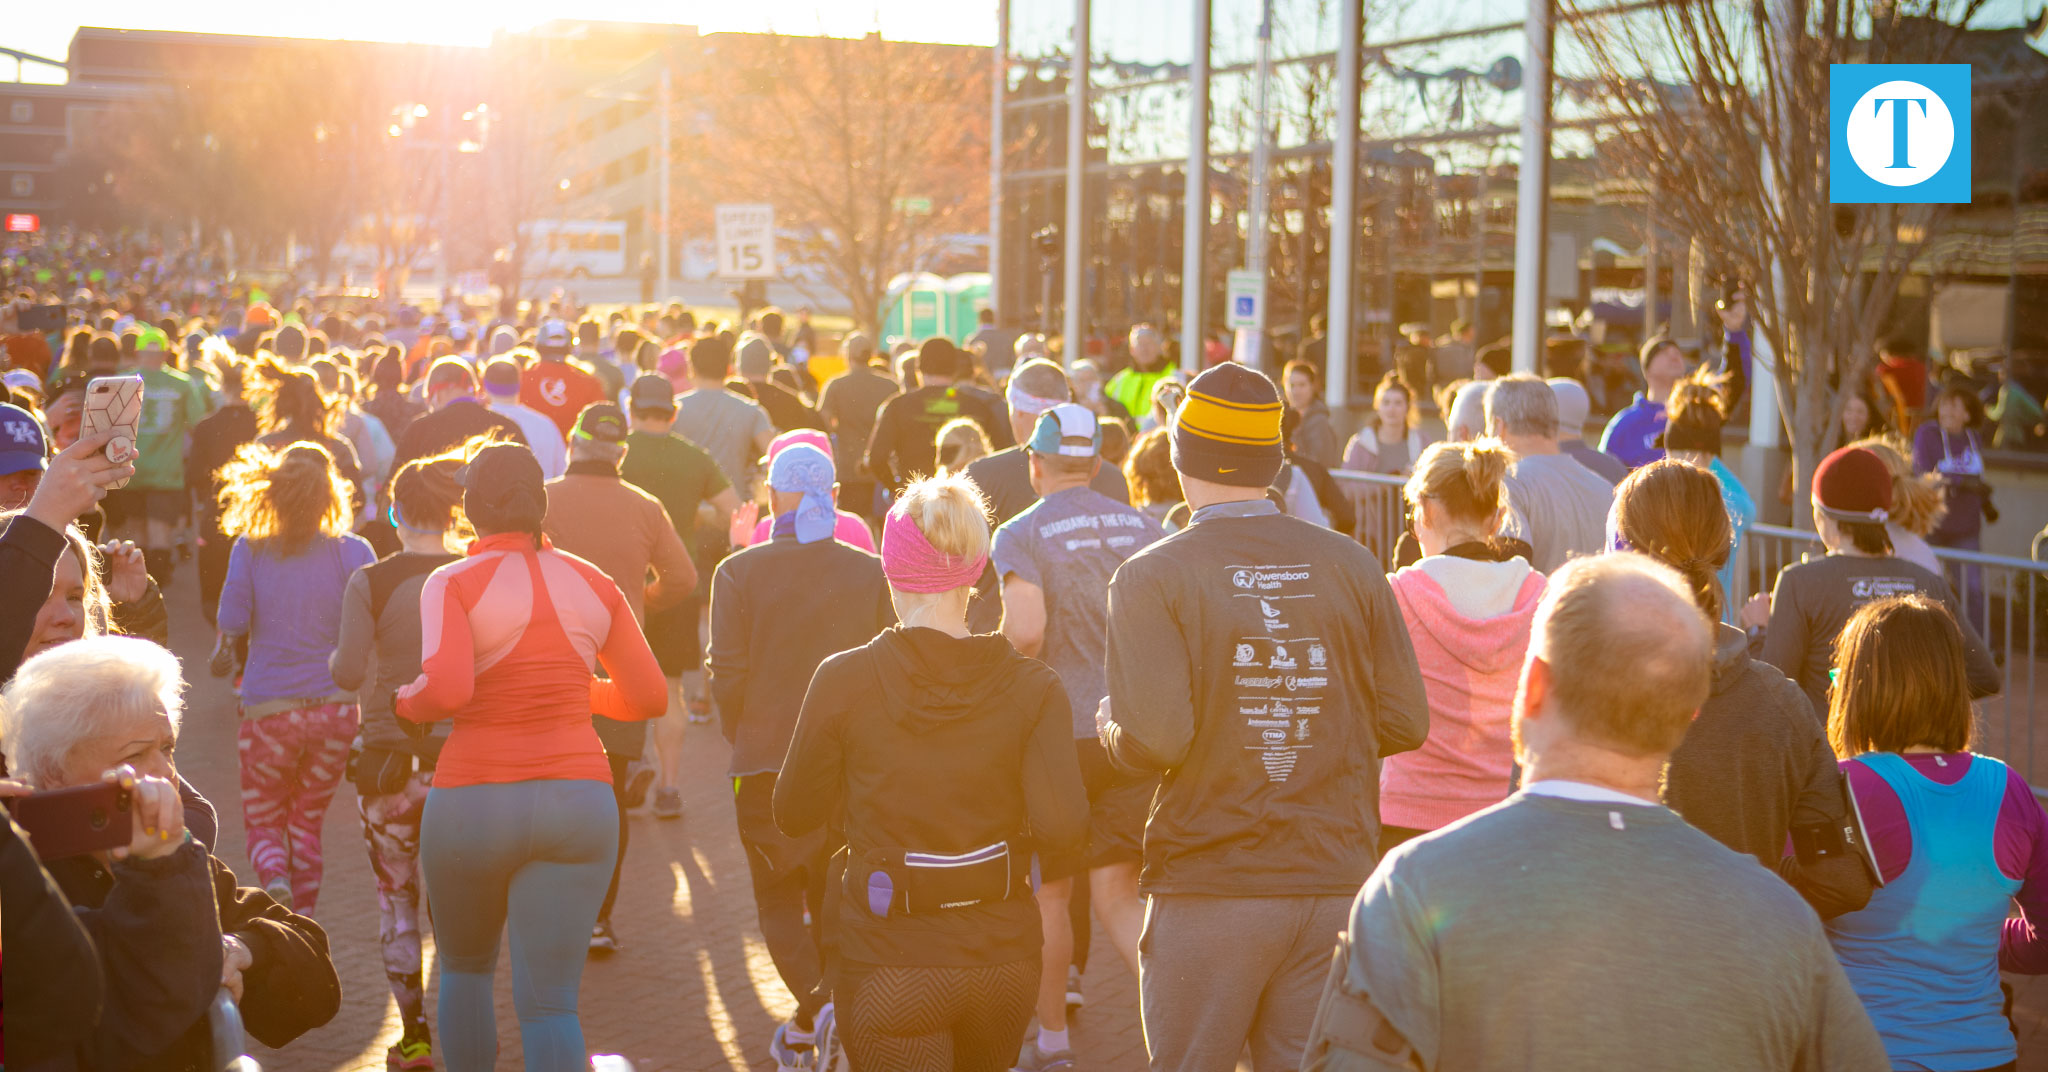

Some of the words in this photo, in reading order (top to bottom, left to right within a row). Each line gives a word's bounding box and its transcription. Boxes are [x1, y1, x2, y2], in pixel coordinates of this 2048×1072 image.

[730, 244, 763, 271] 15
[4, 421, 38, 445] UK
[1040, 515, 1089, 539] GUARDIANS
[1100, 514, 1119, 528] THE
[1255, 571, 1309, 581] Owensboro
[1257, 581, 1282, 589] Health
